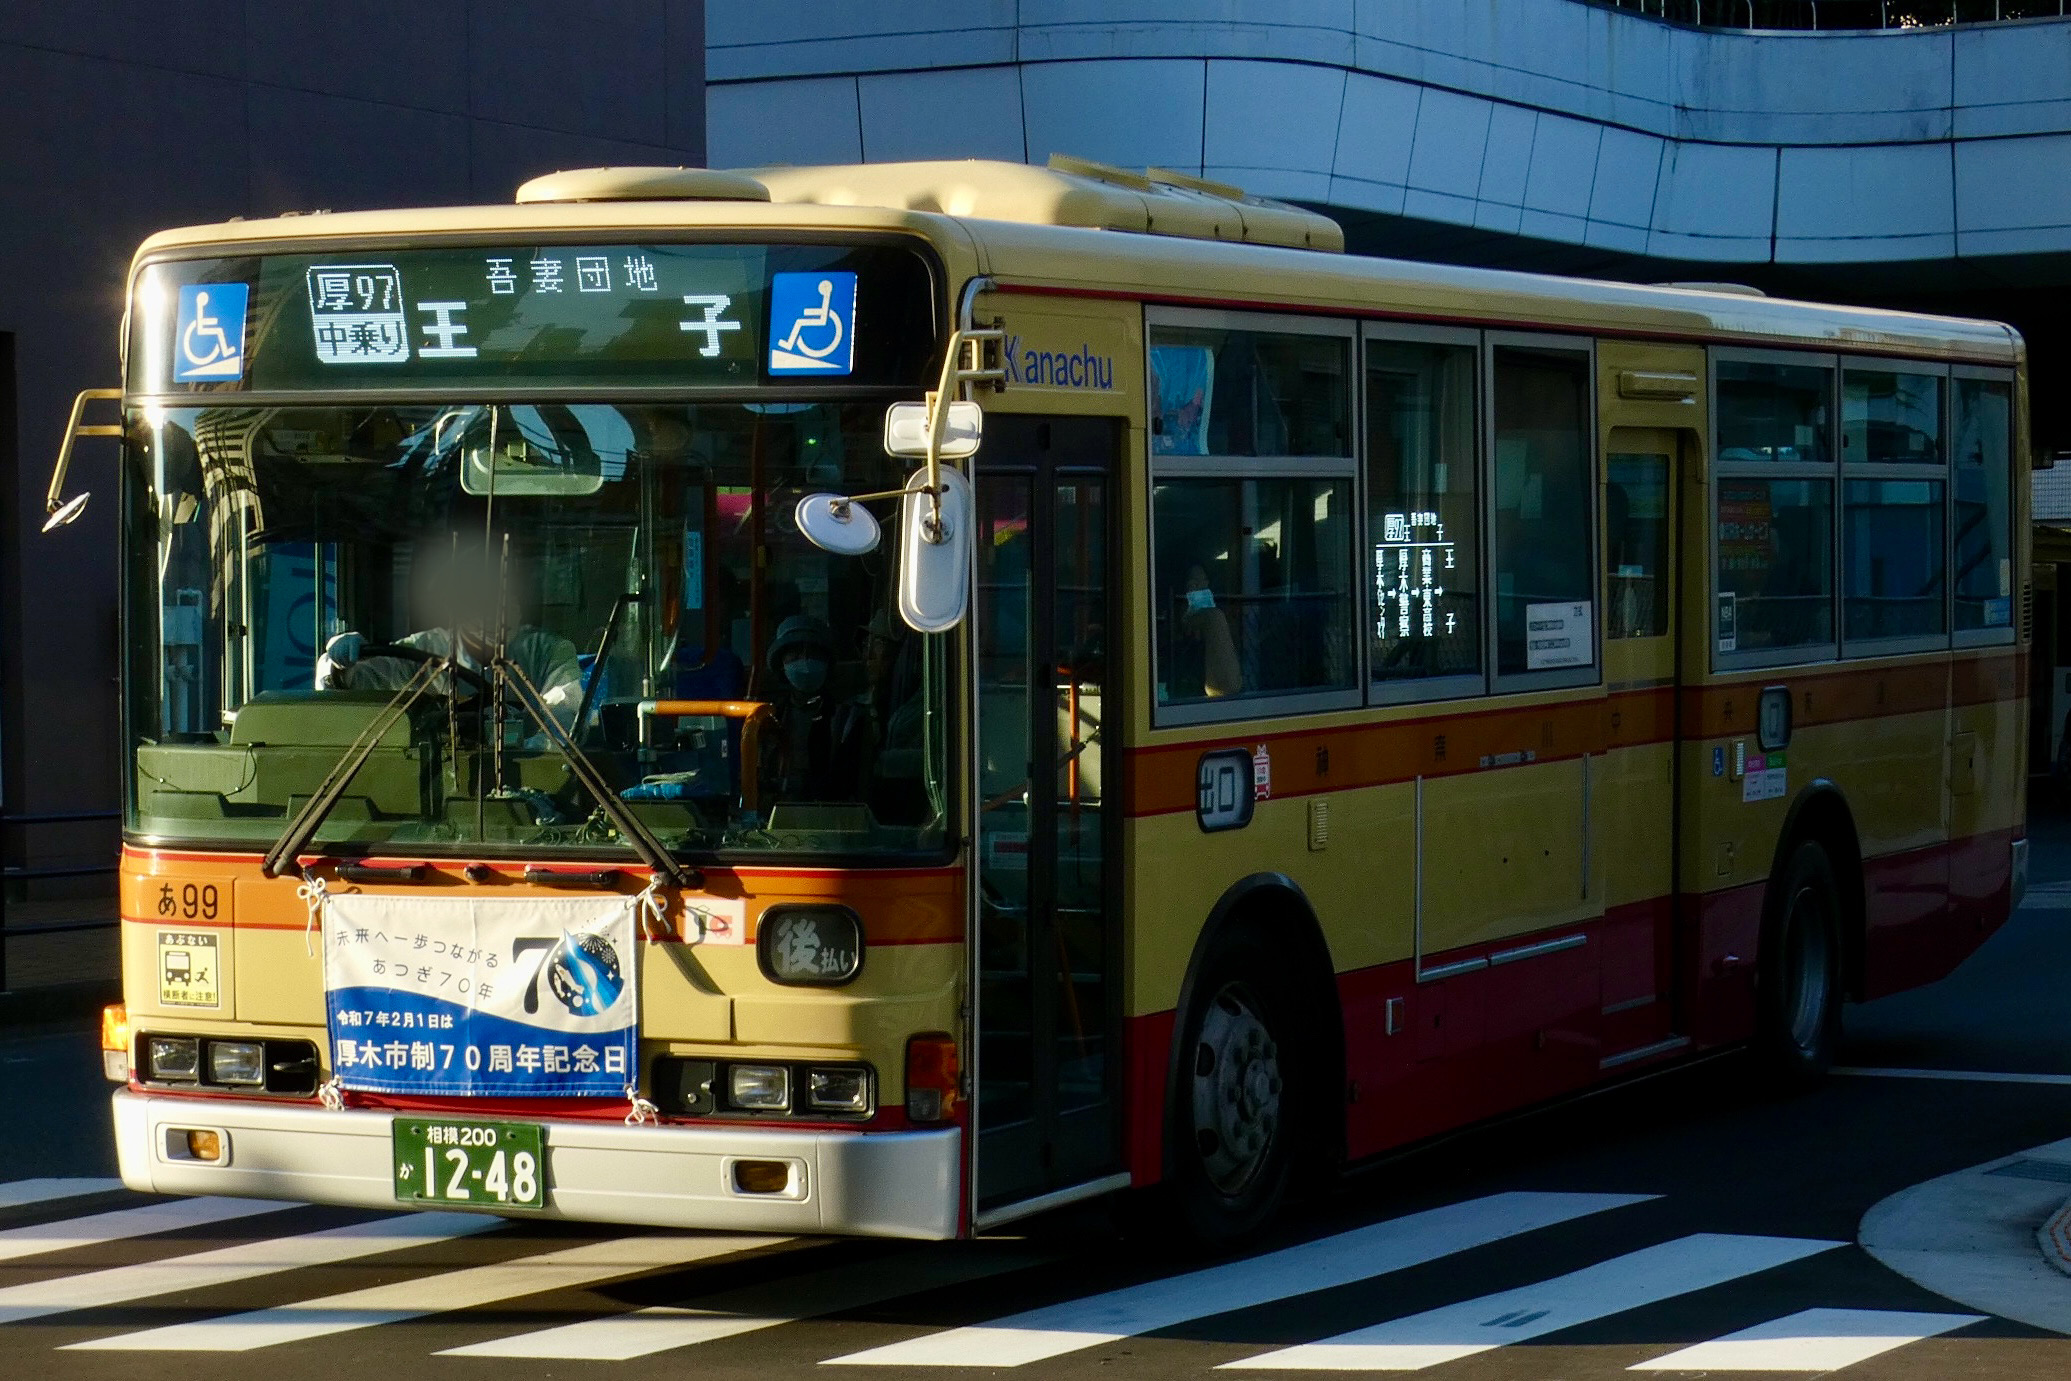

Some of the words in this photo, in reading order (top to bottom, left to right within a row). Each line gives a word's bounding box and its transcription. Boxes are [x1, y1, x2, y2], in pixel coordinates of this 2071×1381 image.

[317, 273, 394, 311] 厚97
[486, 255, 658, 294] 吾妻団地
[318, 321, 403, 357] 中乗り
[1004, 334, 1112, 389] Kanachu
[158, 882, 218, 919] あ99
[164, 934, 208, 945] あぶない
[336, 928, 498, 968] 未来へ一歩つながる
[777, 918, 856, 974] 後払い
[336, 1010, 453, 1029] 令和7年2月1日は
[336, 1039, 626, 1074] 厚木市制70周年記念日
[425, 1146, 537, 1202] 12-48
